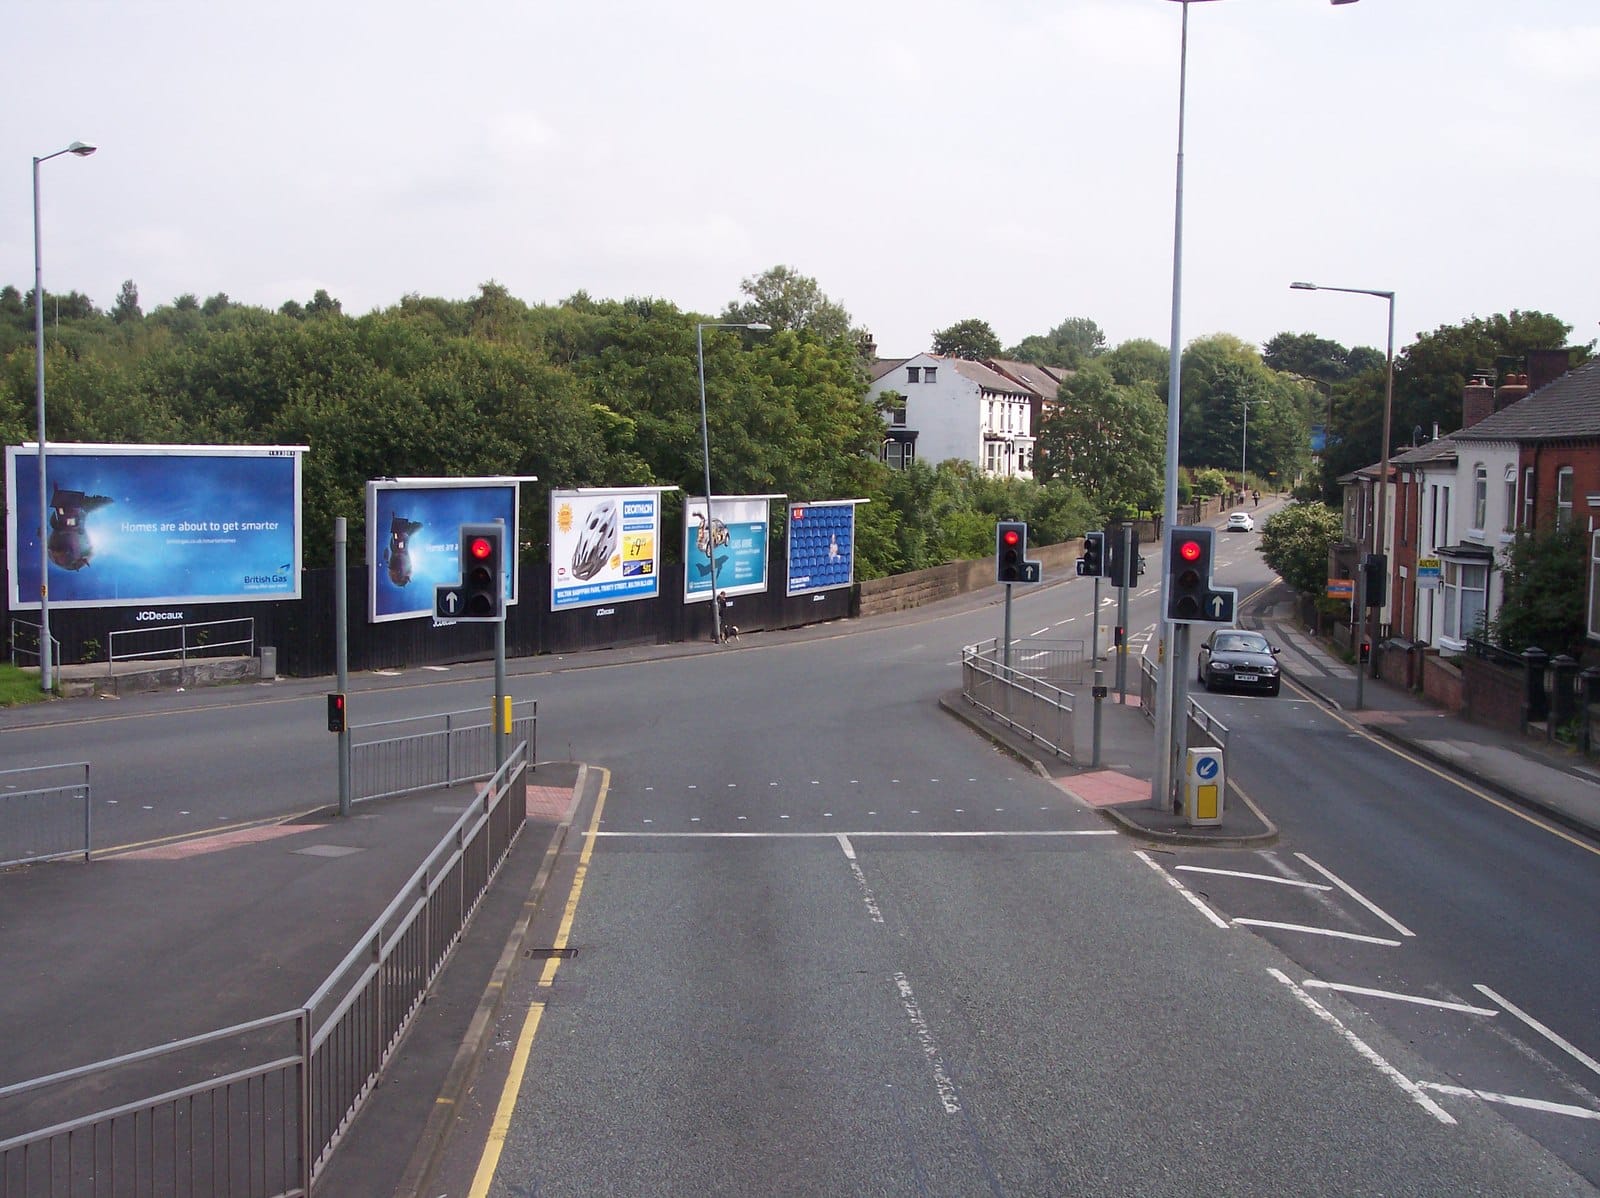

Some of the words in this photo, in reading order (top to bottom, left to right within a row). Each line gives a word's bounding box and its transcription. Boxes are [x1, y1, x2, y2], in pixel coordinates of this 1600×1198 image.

[624, 503, 653, 514] DECATHLON
[121, 522, 157, 532] Homes
[160, 523, 176, 531] are
[178, 521, 207, 531] about
[210, 521, 220, 531] to
[222, 521, 239, 533] get
[241, 521, 278, 531] smarter
[272, 574, 288, 582] Gas
[136, 611, 183, 621] JCDecaux
